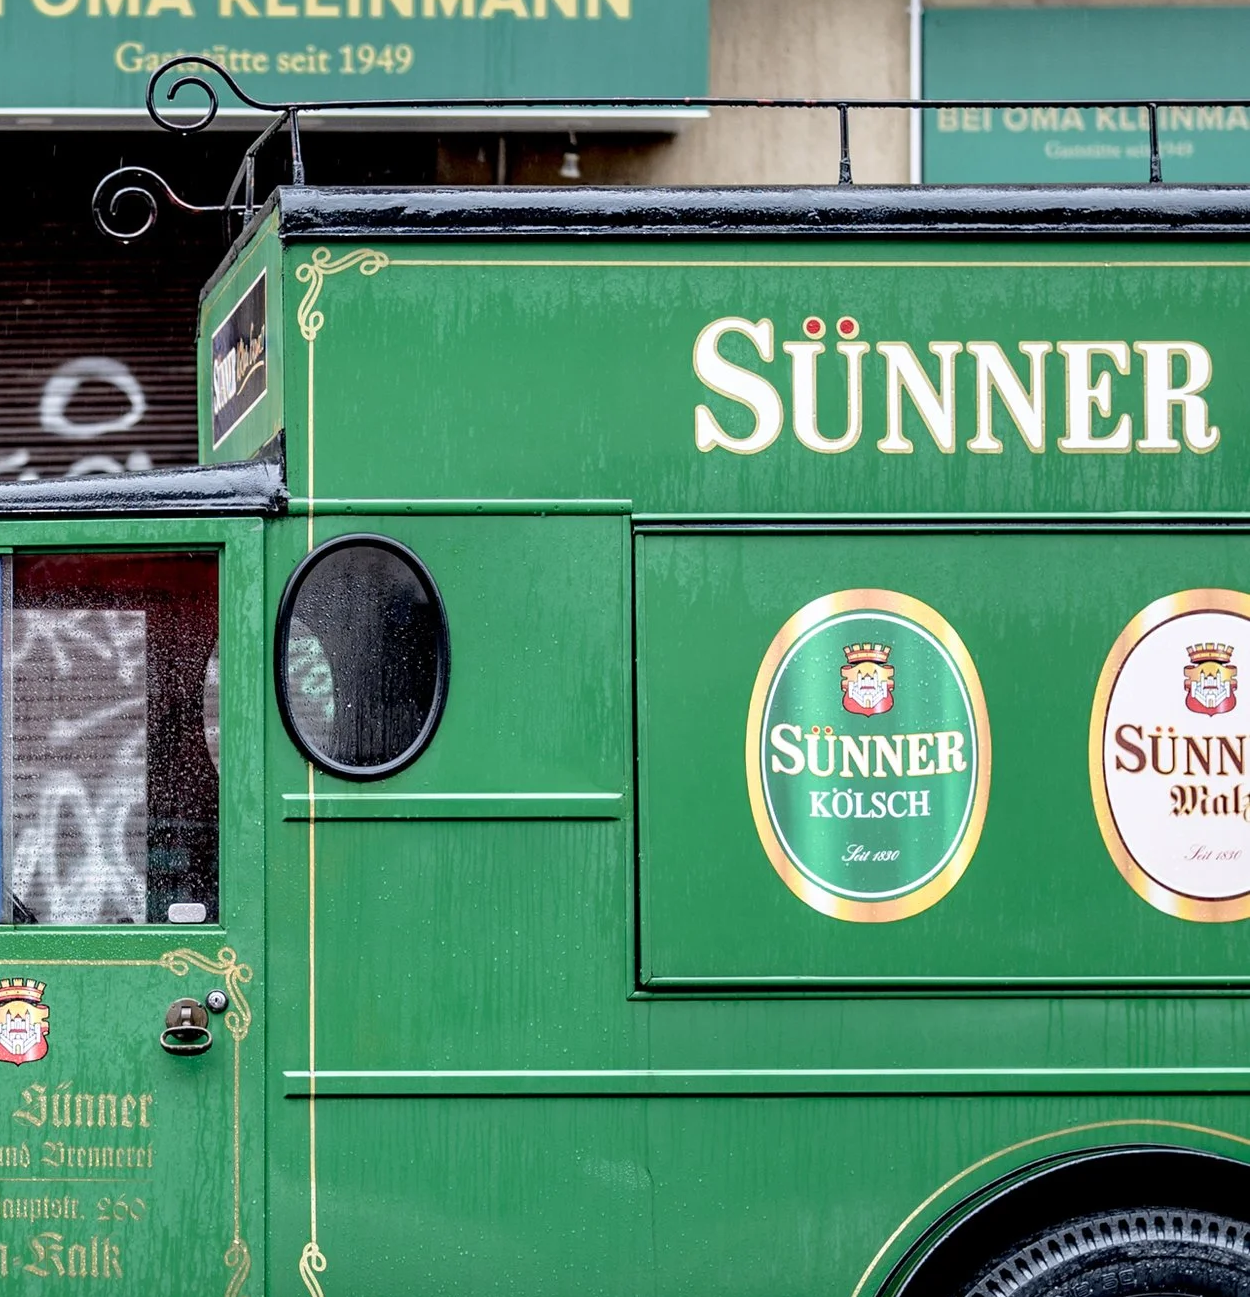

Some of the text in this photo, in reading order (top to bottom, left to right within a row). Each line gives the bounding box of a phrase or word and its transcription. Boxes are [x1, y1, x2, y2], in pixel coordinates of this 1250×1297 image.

[276, 46, 331, 74] seit
[338, 44, 414, 75] 1949
[937, 107, 993, 132] BEI
[1002, 107, 1086, 132] OMA
[693, 315, 1220, 454] SÜNNER
[770, 723, 968, 778] SÜNNER
[809, 787, 931, 819] KÖLSCH
[841, 844, 900, 863] Seit 1830
[1183, 844, 1243, 861] Seit 1830
[12, 1080, 155, 1128] Sünner
[40, 1139, 155, 1168] Brennerei
